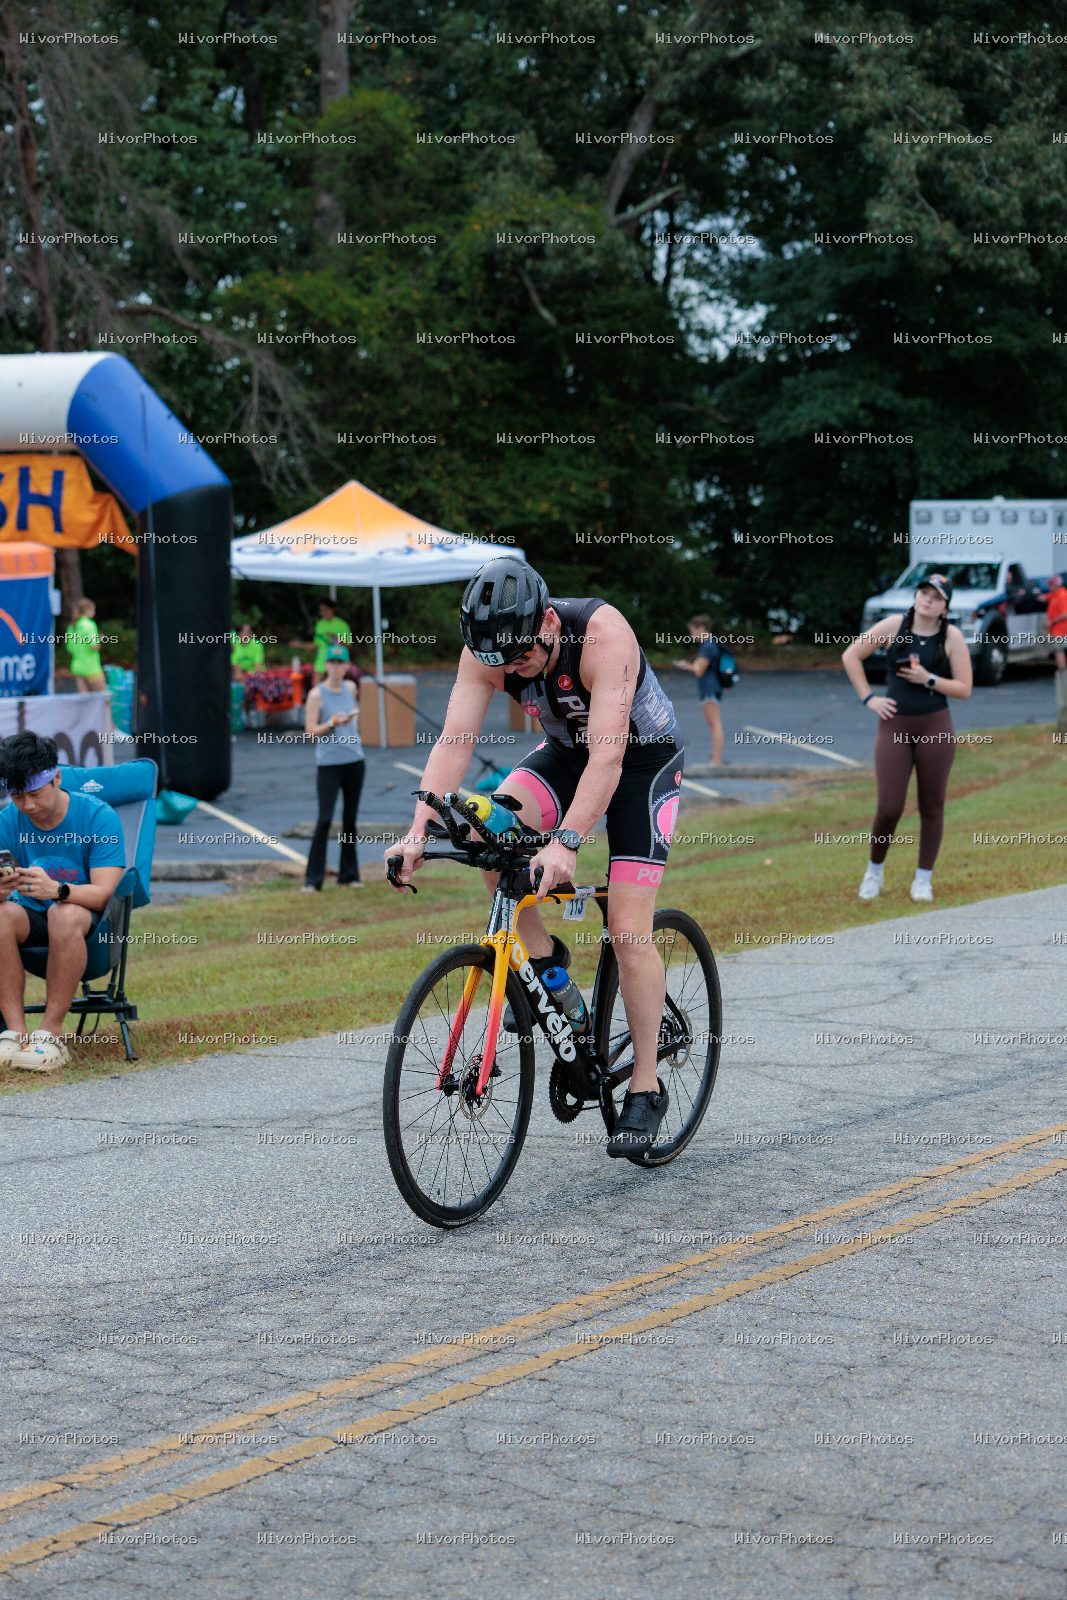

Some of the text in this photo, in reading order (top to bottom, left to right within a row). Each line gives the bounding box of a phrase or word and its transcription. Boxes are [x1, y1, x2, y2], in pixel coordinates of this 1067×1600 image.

[0, 465, 64, 533] H
[478, 653, 499, 664] 113
[636, 867, 663, 884] PO
[569, 898, 584, 916] 113
